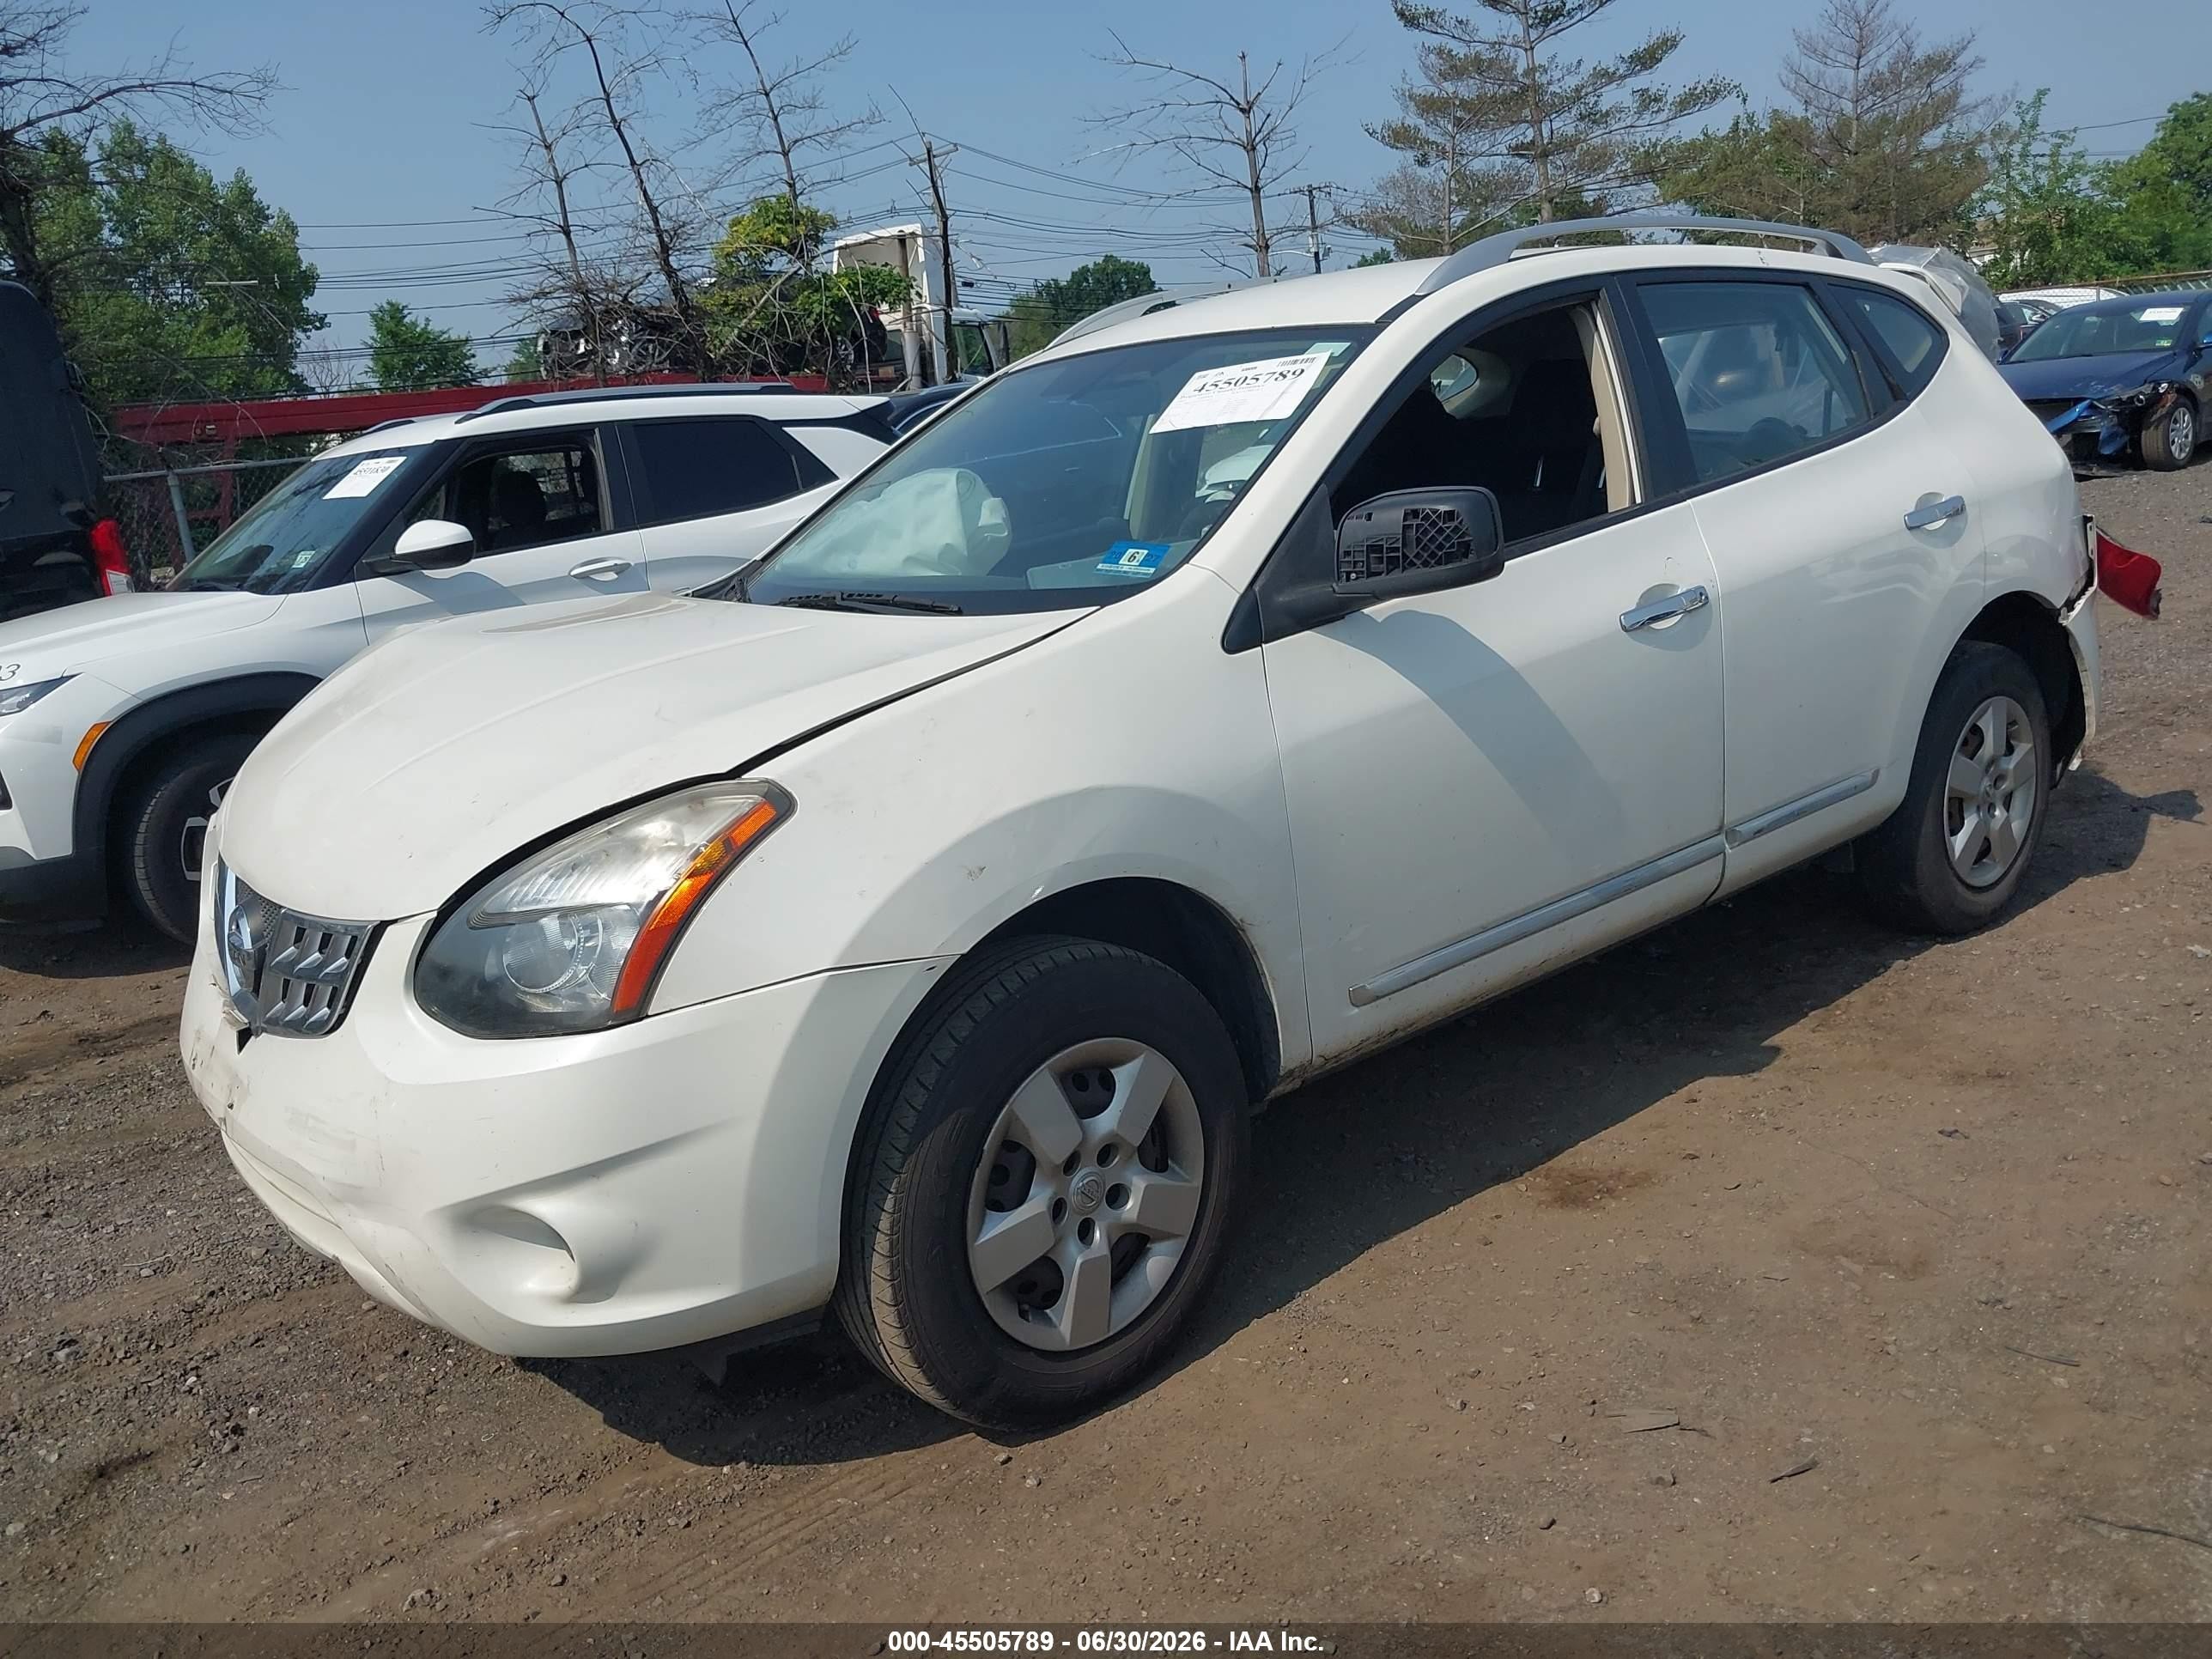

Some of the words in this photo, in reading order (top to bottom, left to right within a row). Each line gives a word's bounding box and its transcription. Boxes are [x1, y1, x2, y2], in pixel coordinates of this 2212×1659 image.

[1193, 368, 1305, 393] 45505789
[1127, 550, 1140, 563] 6
[0, 663, 21, 682] 3
